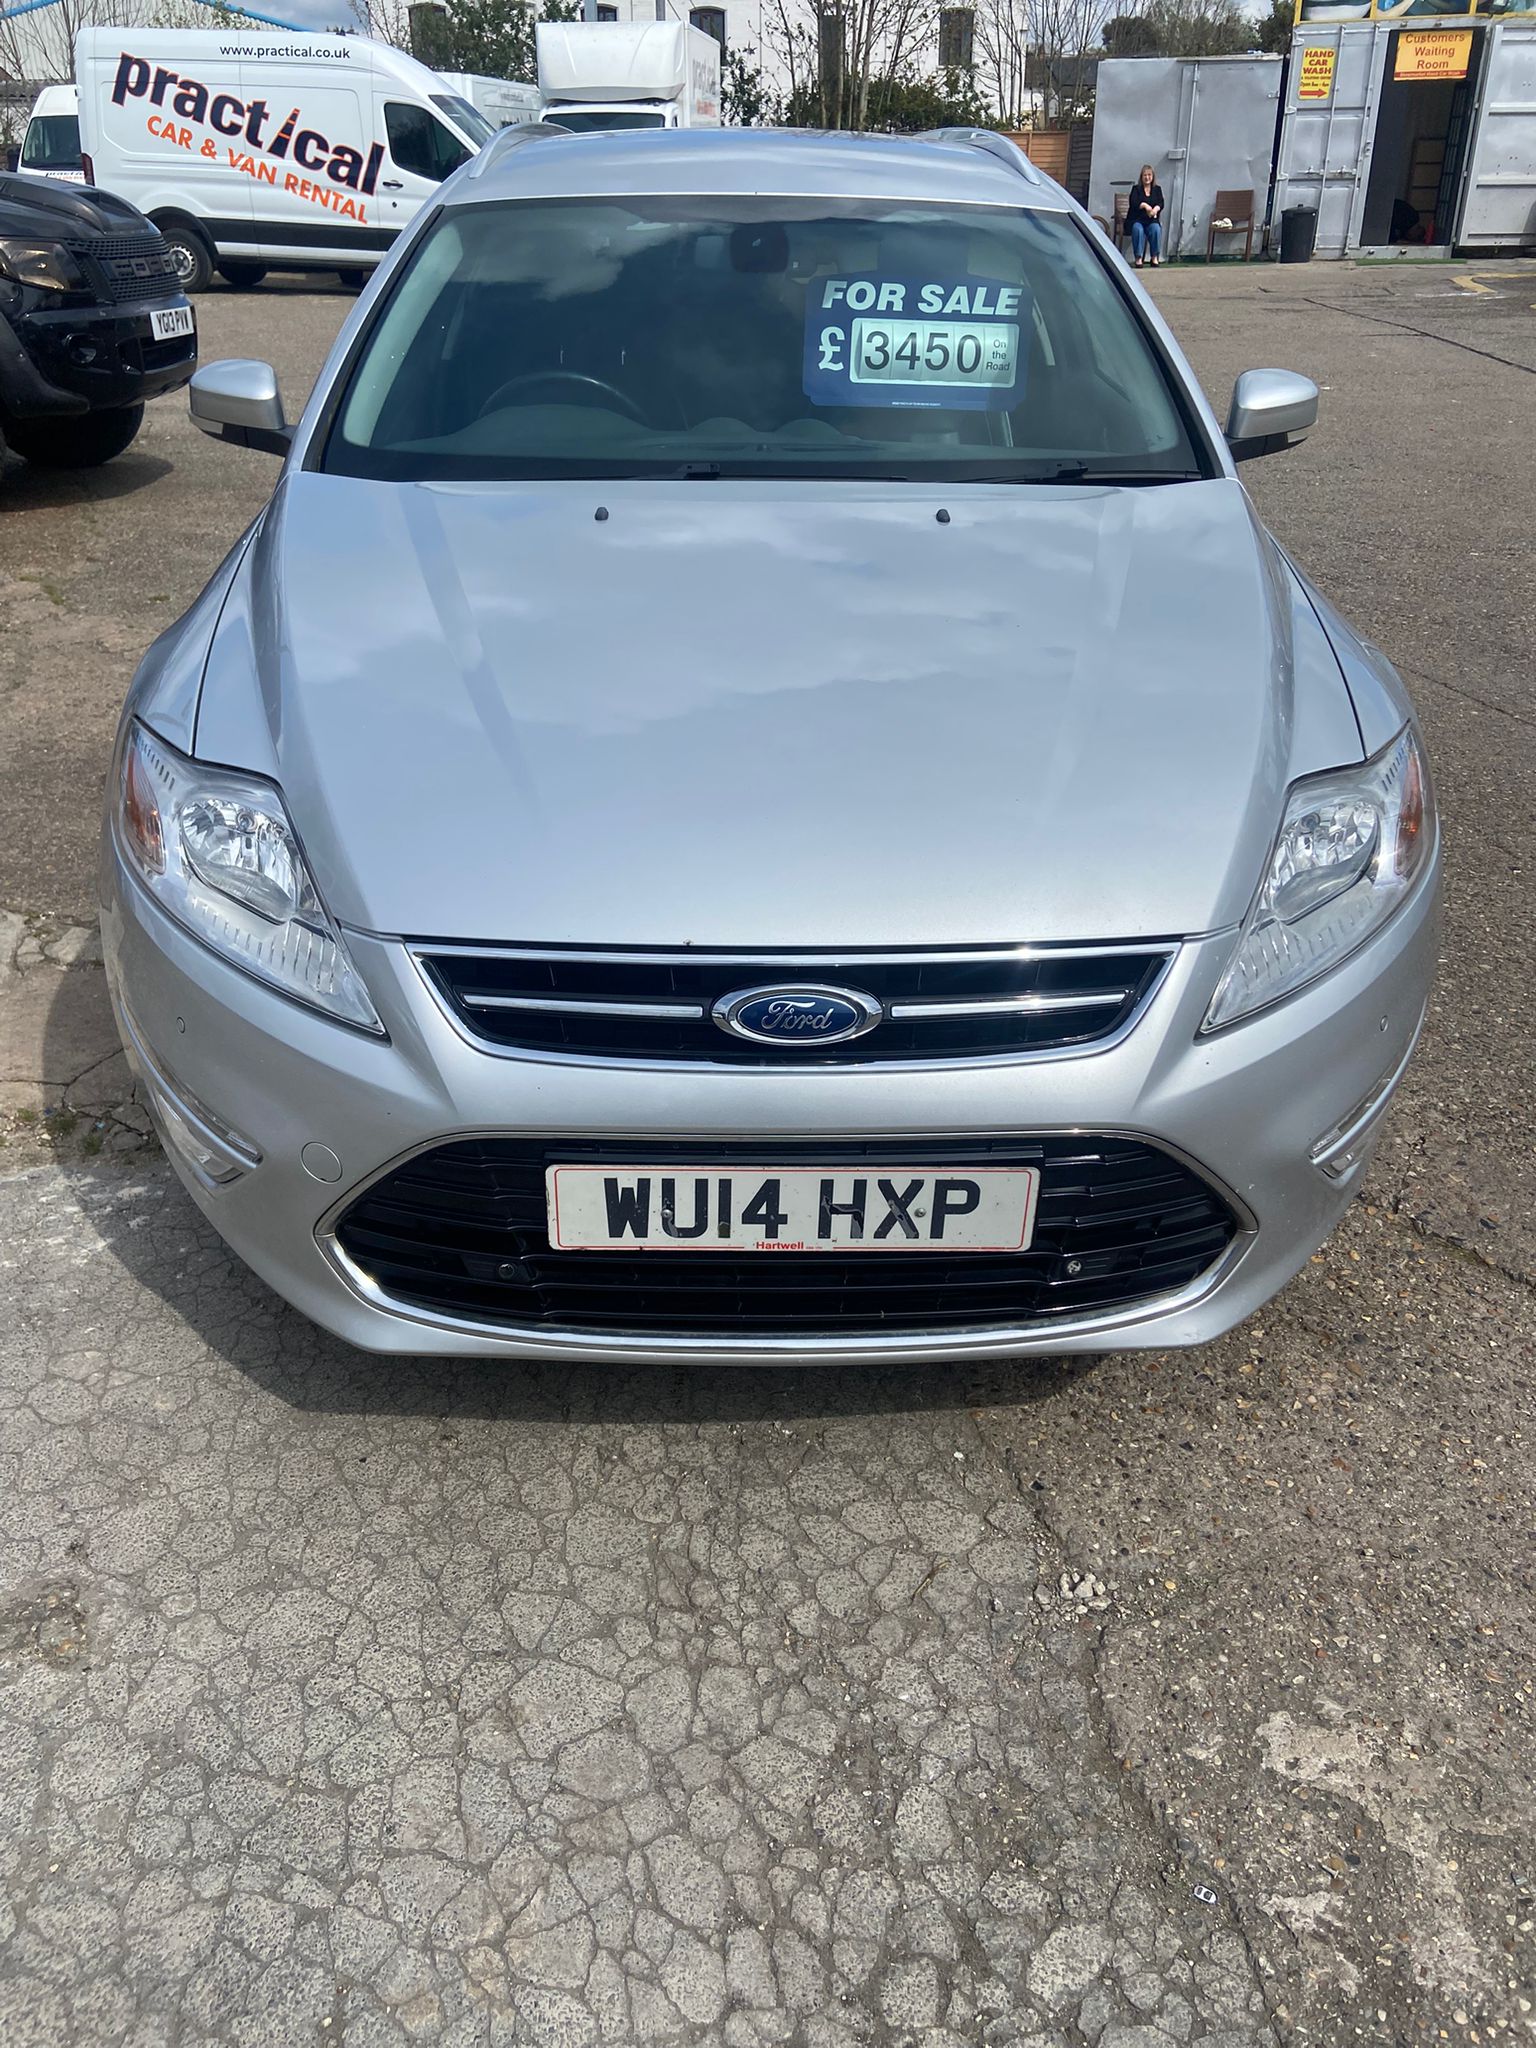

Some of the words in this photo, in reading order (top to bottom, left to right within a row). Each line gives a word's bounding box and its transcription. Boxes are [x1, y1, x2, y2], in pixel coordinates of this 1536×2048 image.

[1405, 32, 1465, 44] Customers
[219, 45, 350, 60] www.practical.co.uk
[1304, 50, 1334, 58] HAND
[1414, 46, 1455, 57] Waiting
[1416, 60, 1449, 69] Room
[111, 51, 386, 196] practical
[147, 115, 192, 150] CAR
[200, 138, 217, 160] &
[227, 147, 277, 185] VAN
[284, 172, 368, 224] RENTAL
[821, 280, 906, 312] FOR
[917, 284, 1023, 316] SALE
[993, 339, 1006, 348] On
[818, 326, 845, 372] £
[864, 330, 982, 374] 3450
[992, 351, 1007, 360] the
[986, 361, 1010, 371] Road
[761, 1000, 835, 1030] Ford
[603, 1177, 788, 1239] WU14
[817, 1178, 981, 1239] HXP
[756, 1241, 804, 1249] Hartwell
